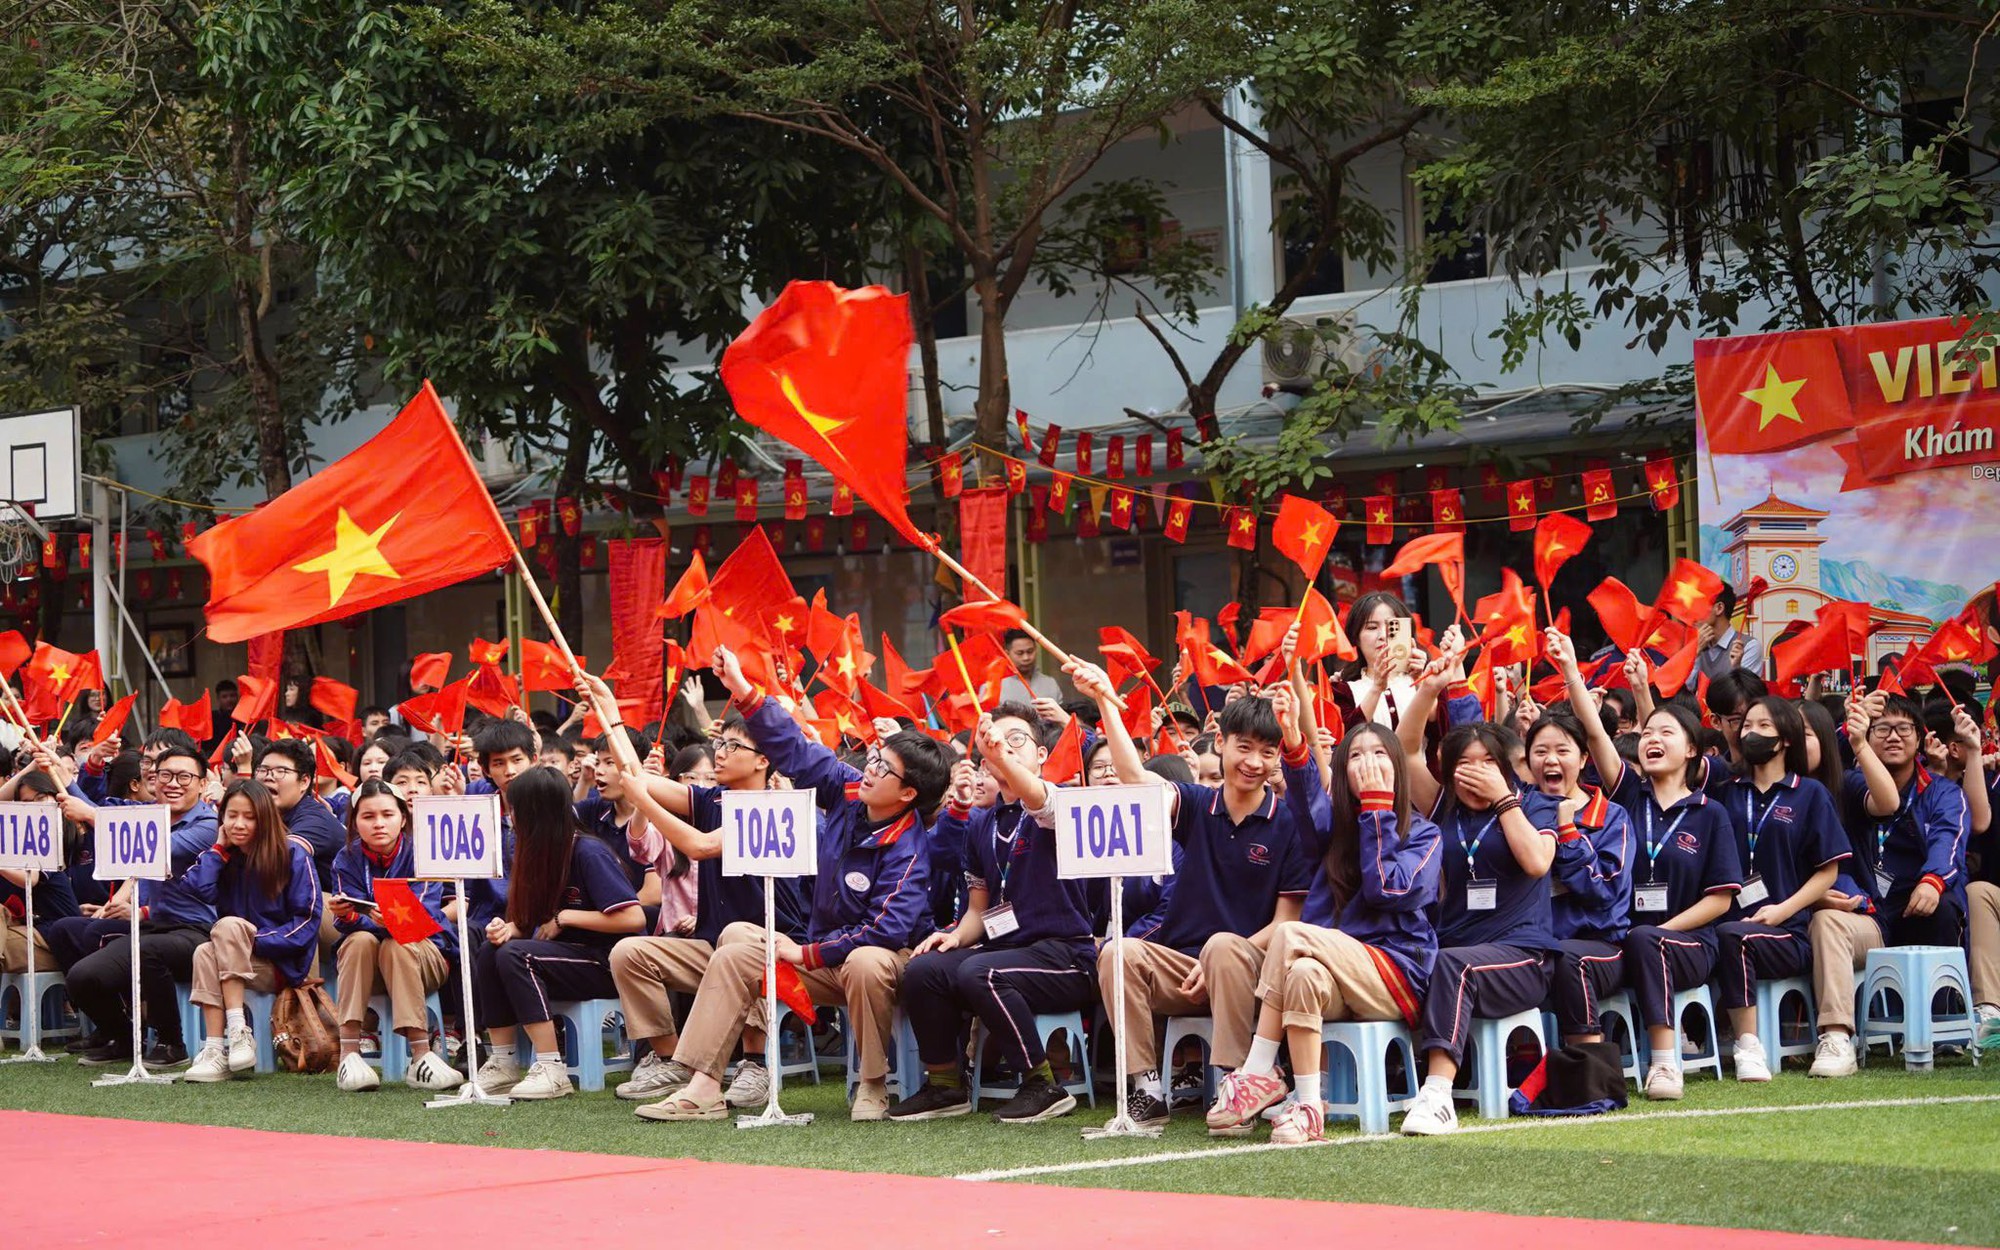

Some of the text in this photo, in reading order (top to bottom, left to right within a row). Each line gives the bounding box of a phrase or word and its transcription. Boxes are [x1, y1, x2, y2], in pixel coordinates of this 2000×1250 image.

[1905, 421, 1993, 460] Khám
[109, 820, 158, 864] 10A9
[427, 813, 485, 861] 10A6
[735, 807, 796, 859] 10A3
[1071, 803, 1143, 859] 10A1
